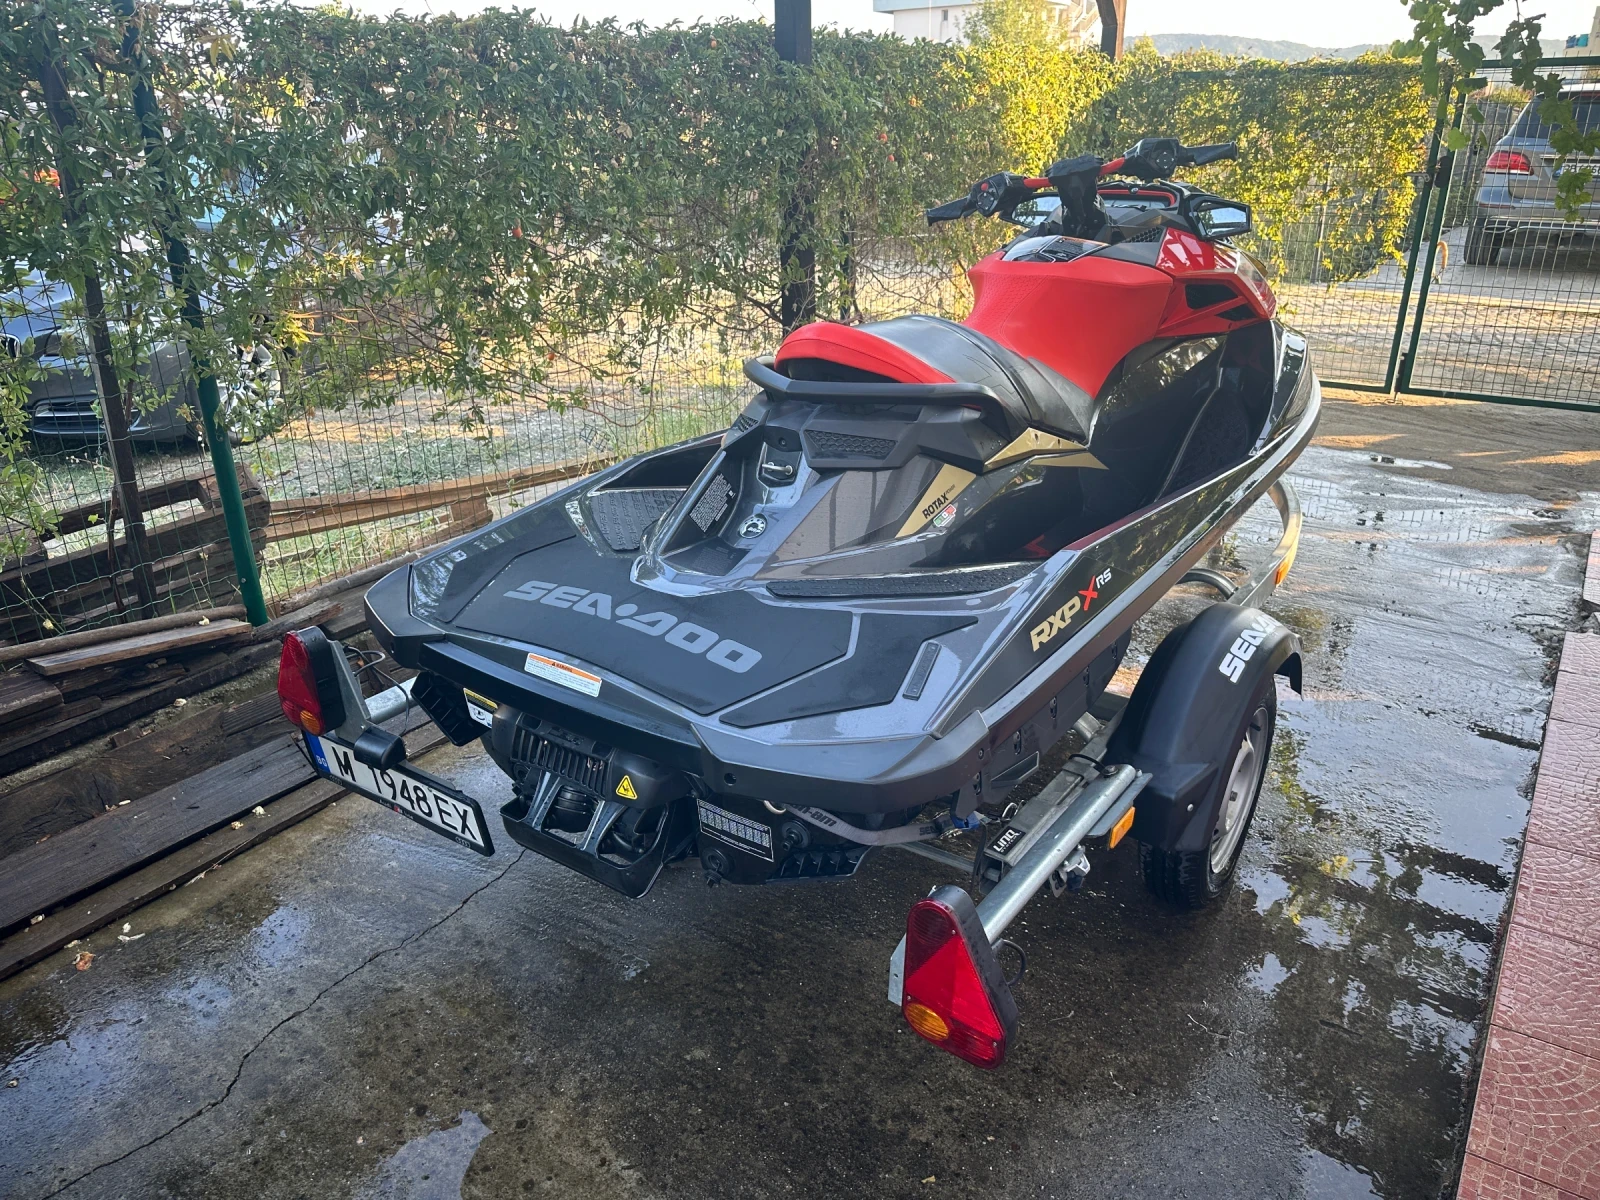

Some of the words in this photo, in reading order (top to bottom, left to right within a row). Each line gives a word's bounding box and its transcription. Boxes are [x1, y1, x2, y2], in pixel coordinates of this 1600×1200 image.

[921, 491, 949, 519] ROTAX
[1095, 567, 1112, 589] RS
[315, 754, 328, 767] BG
[331, 746, 357, 782] M
[367, 765, 433, 818] 1948
[431, 793, 477, 841] EX
